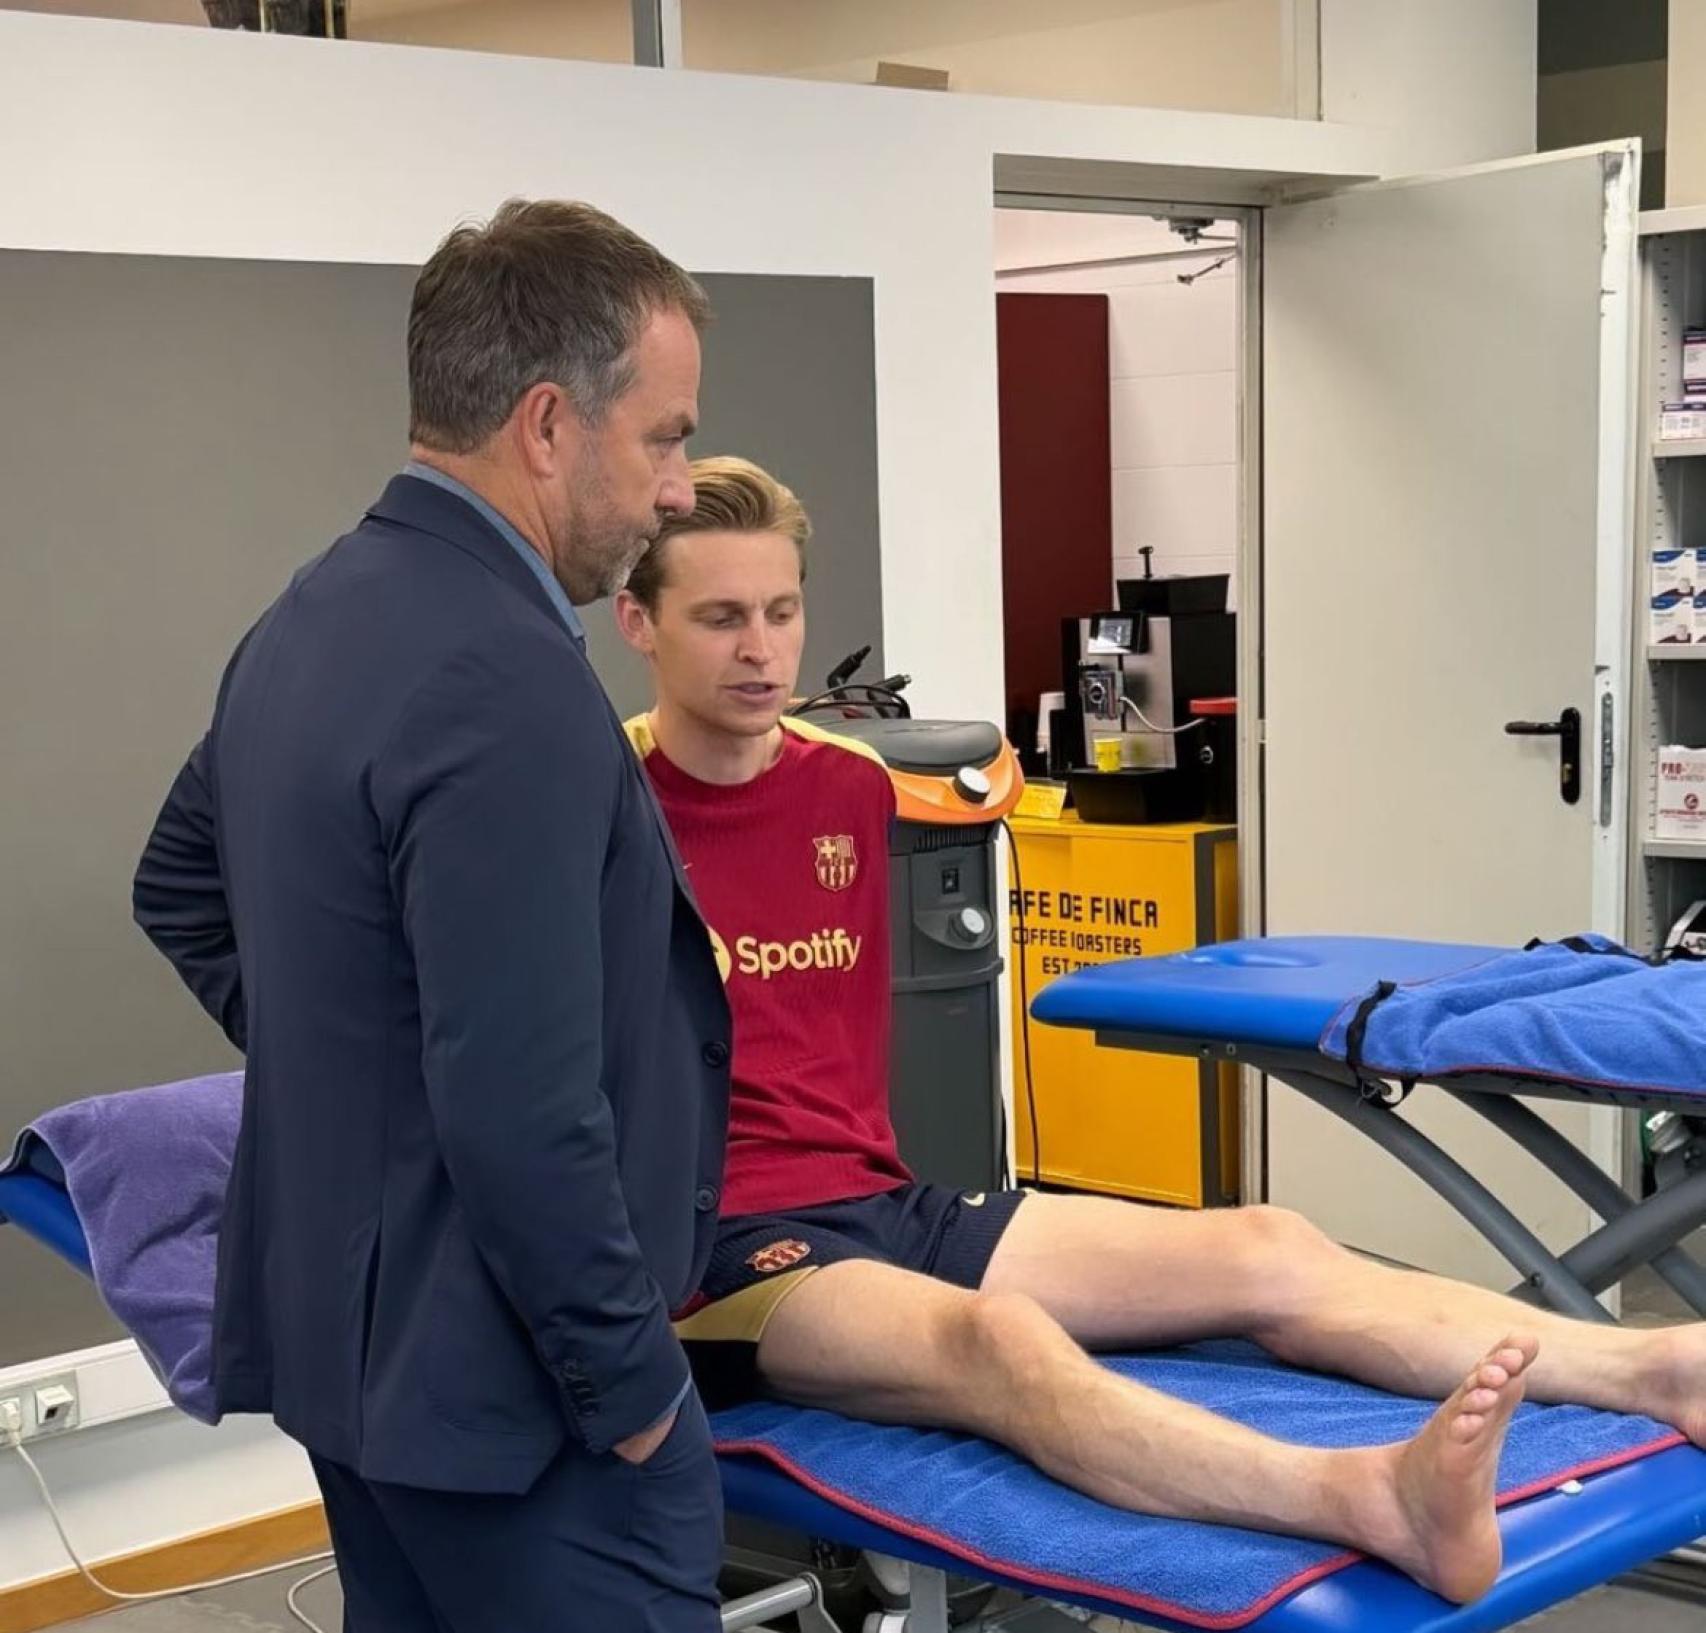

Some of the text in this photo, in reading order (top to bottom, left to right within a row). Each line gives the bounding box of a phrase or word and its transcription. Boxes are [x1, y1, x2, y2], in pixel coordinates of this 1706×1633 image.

[1059, 892, 1082, 922] DE
[1090, 896, 1158, 928] FINCA
[1012, 927, 1067, 948] COFFEE
[735, 928, 862, 979] Spotify
[1042, 956, 1070, 975] EST
